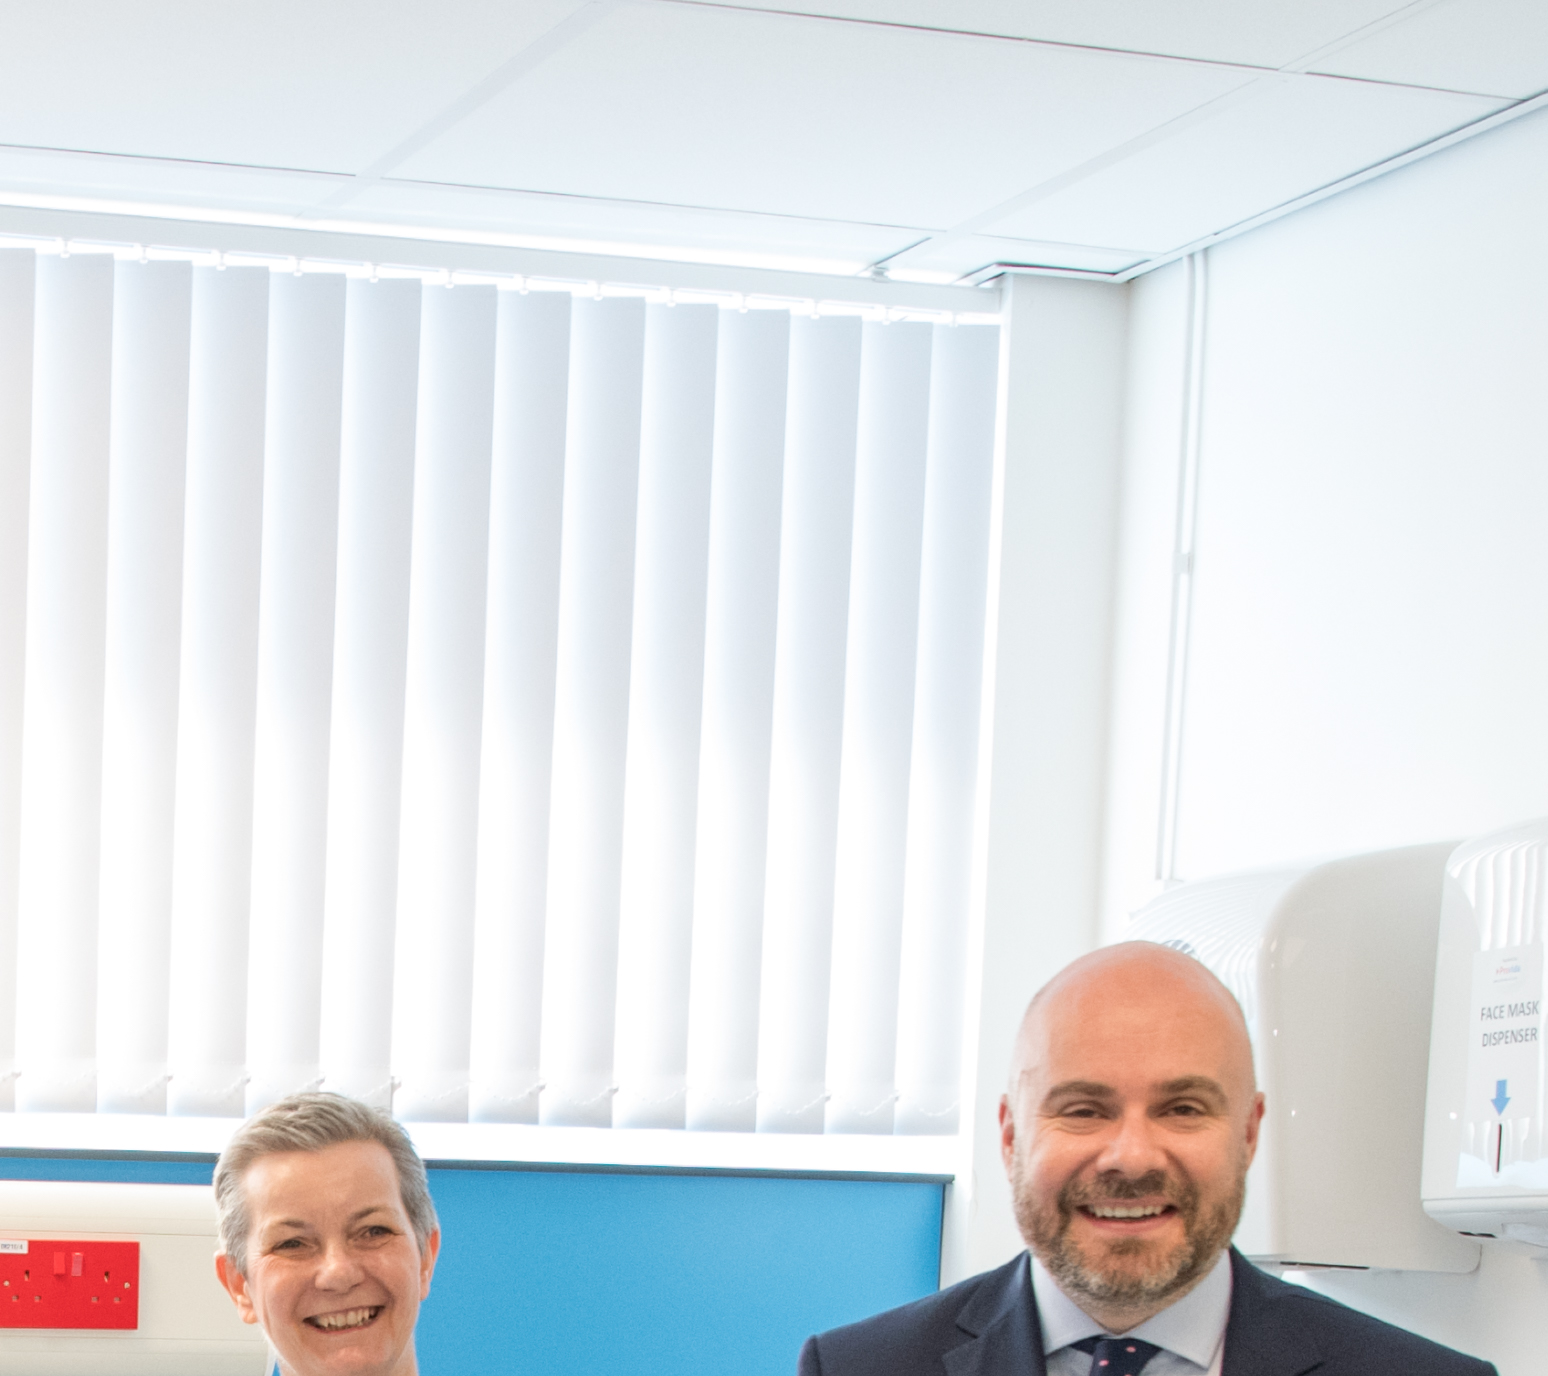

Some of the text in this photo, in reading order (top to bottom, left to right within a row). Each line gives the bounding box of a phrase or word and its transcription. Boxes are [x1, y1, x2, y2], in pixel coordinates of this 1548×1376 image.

[1480, 1000, 1540, 1021] FACE MASK
[1482, 1027, 1538, 1047] DISPENSER
